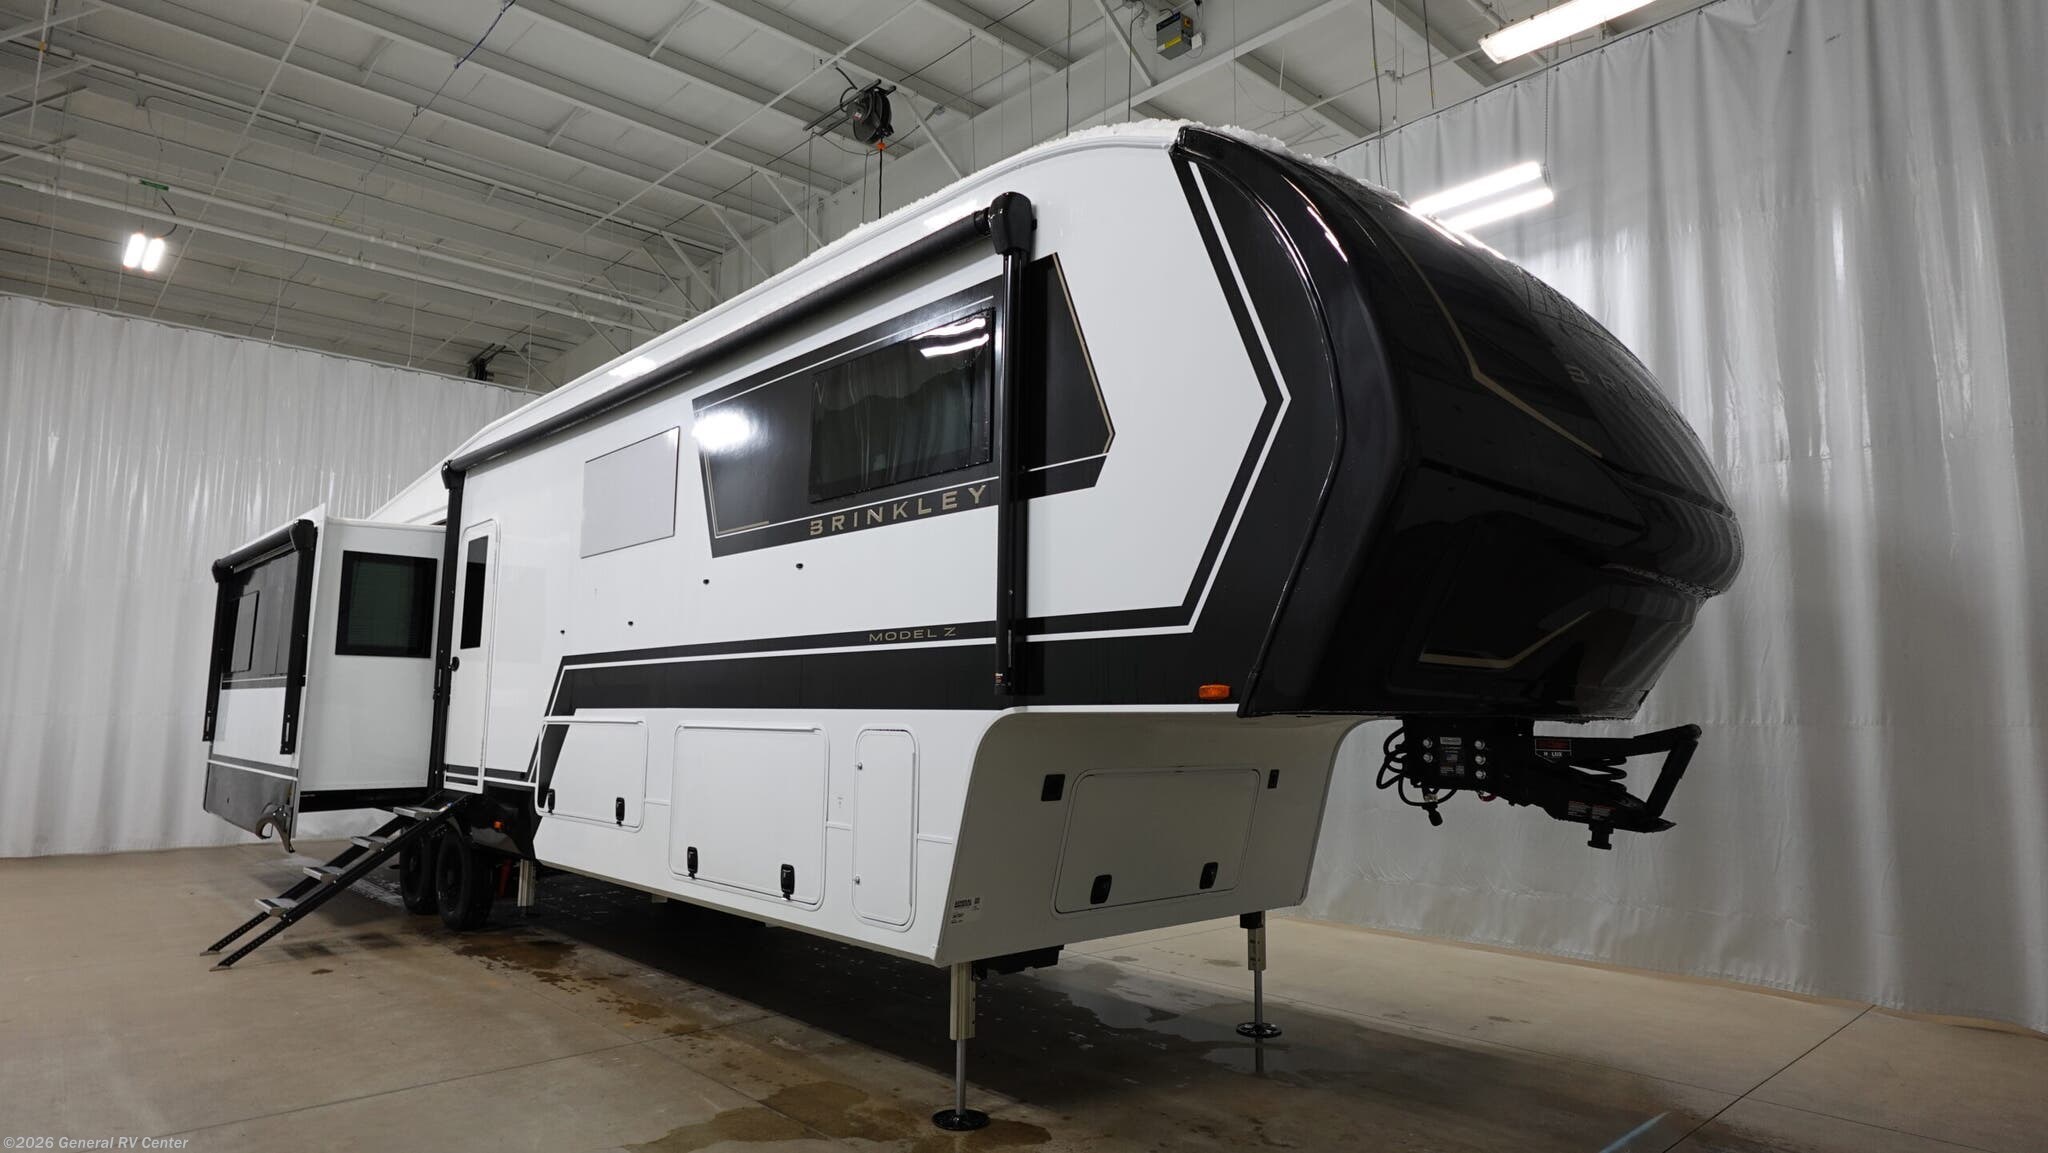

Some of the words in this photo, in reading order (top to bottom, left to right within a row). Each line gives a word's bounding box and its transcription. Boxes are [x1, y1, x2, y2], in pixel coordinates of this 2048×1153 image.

[809, 484, 987, 536] BRINKLEY
[868, 628, 938, 643] MODEL
[943, 626, 957, 638] Z
